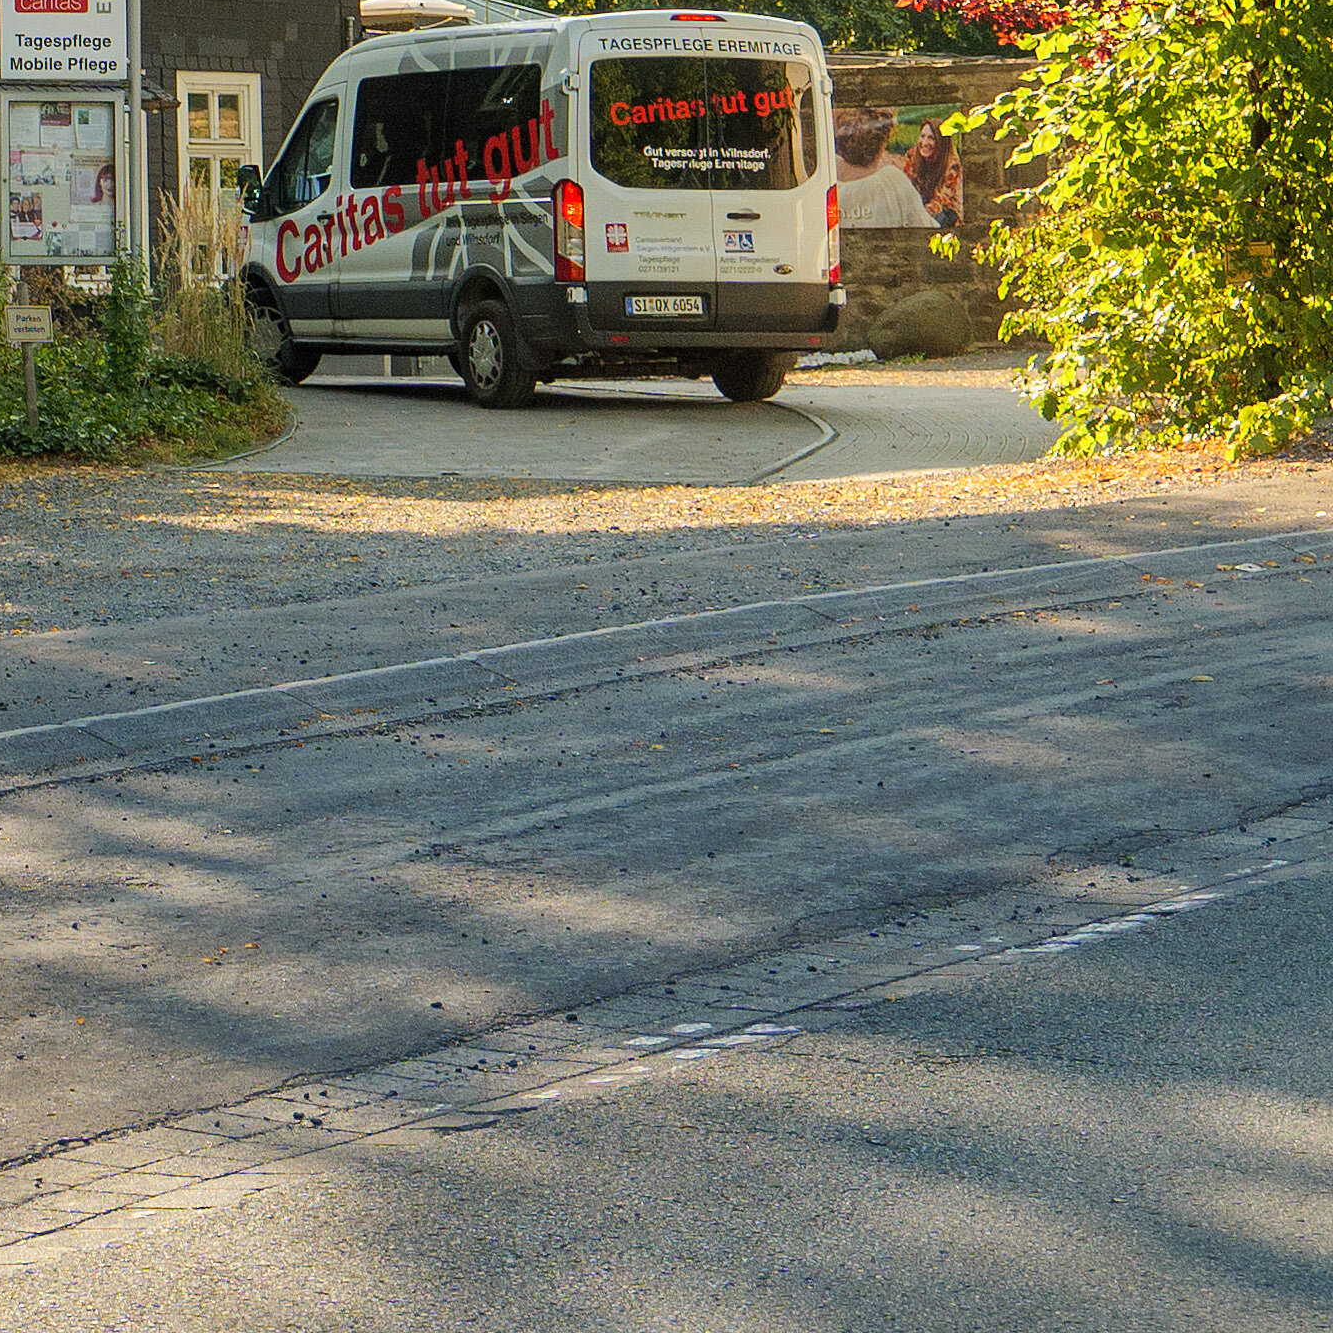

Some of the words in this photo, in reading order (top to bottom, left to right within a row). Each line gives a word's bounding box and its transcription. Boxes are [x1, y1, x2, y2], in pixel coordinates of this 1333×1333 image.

[15, 34, 112, 51] Tagespflege
[598, 38, 713, 52] TAGESPFLEGE
[718, 39, 802, 56] EREMITAGE
[10, 57, 63, 71] Mobile
[68, 57, 118, 74] Pflege
[610, 95, 706, 126] Caritas
[753, 85, 795, 117] gut
[643, 145, 663, 157] Gut
[708, 147, 718, 157] in
[276, 185, 405, 284] Caritas
[416, 139, 471, 219] tut
[484, 99, 559, 203] gut
[637, 255, 681, 264] Tagespflege
[634, 298, 648, 312] SI
[655, 298, 669, 312] QX
[673, 298, 700, 312] 6054
[15, 314, 42, 323] Parken
[13, 325, 46, 333] verboten
